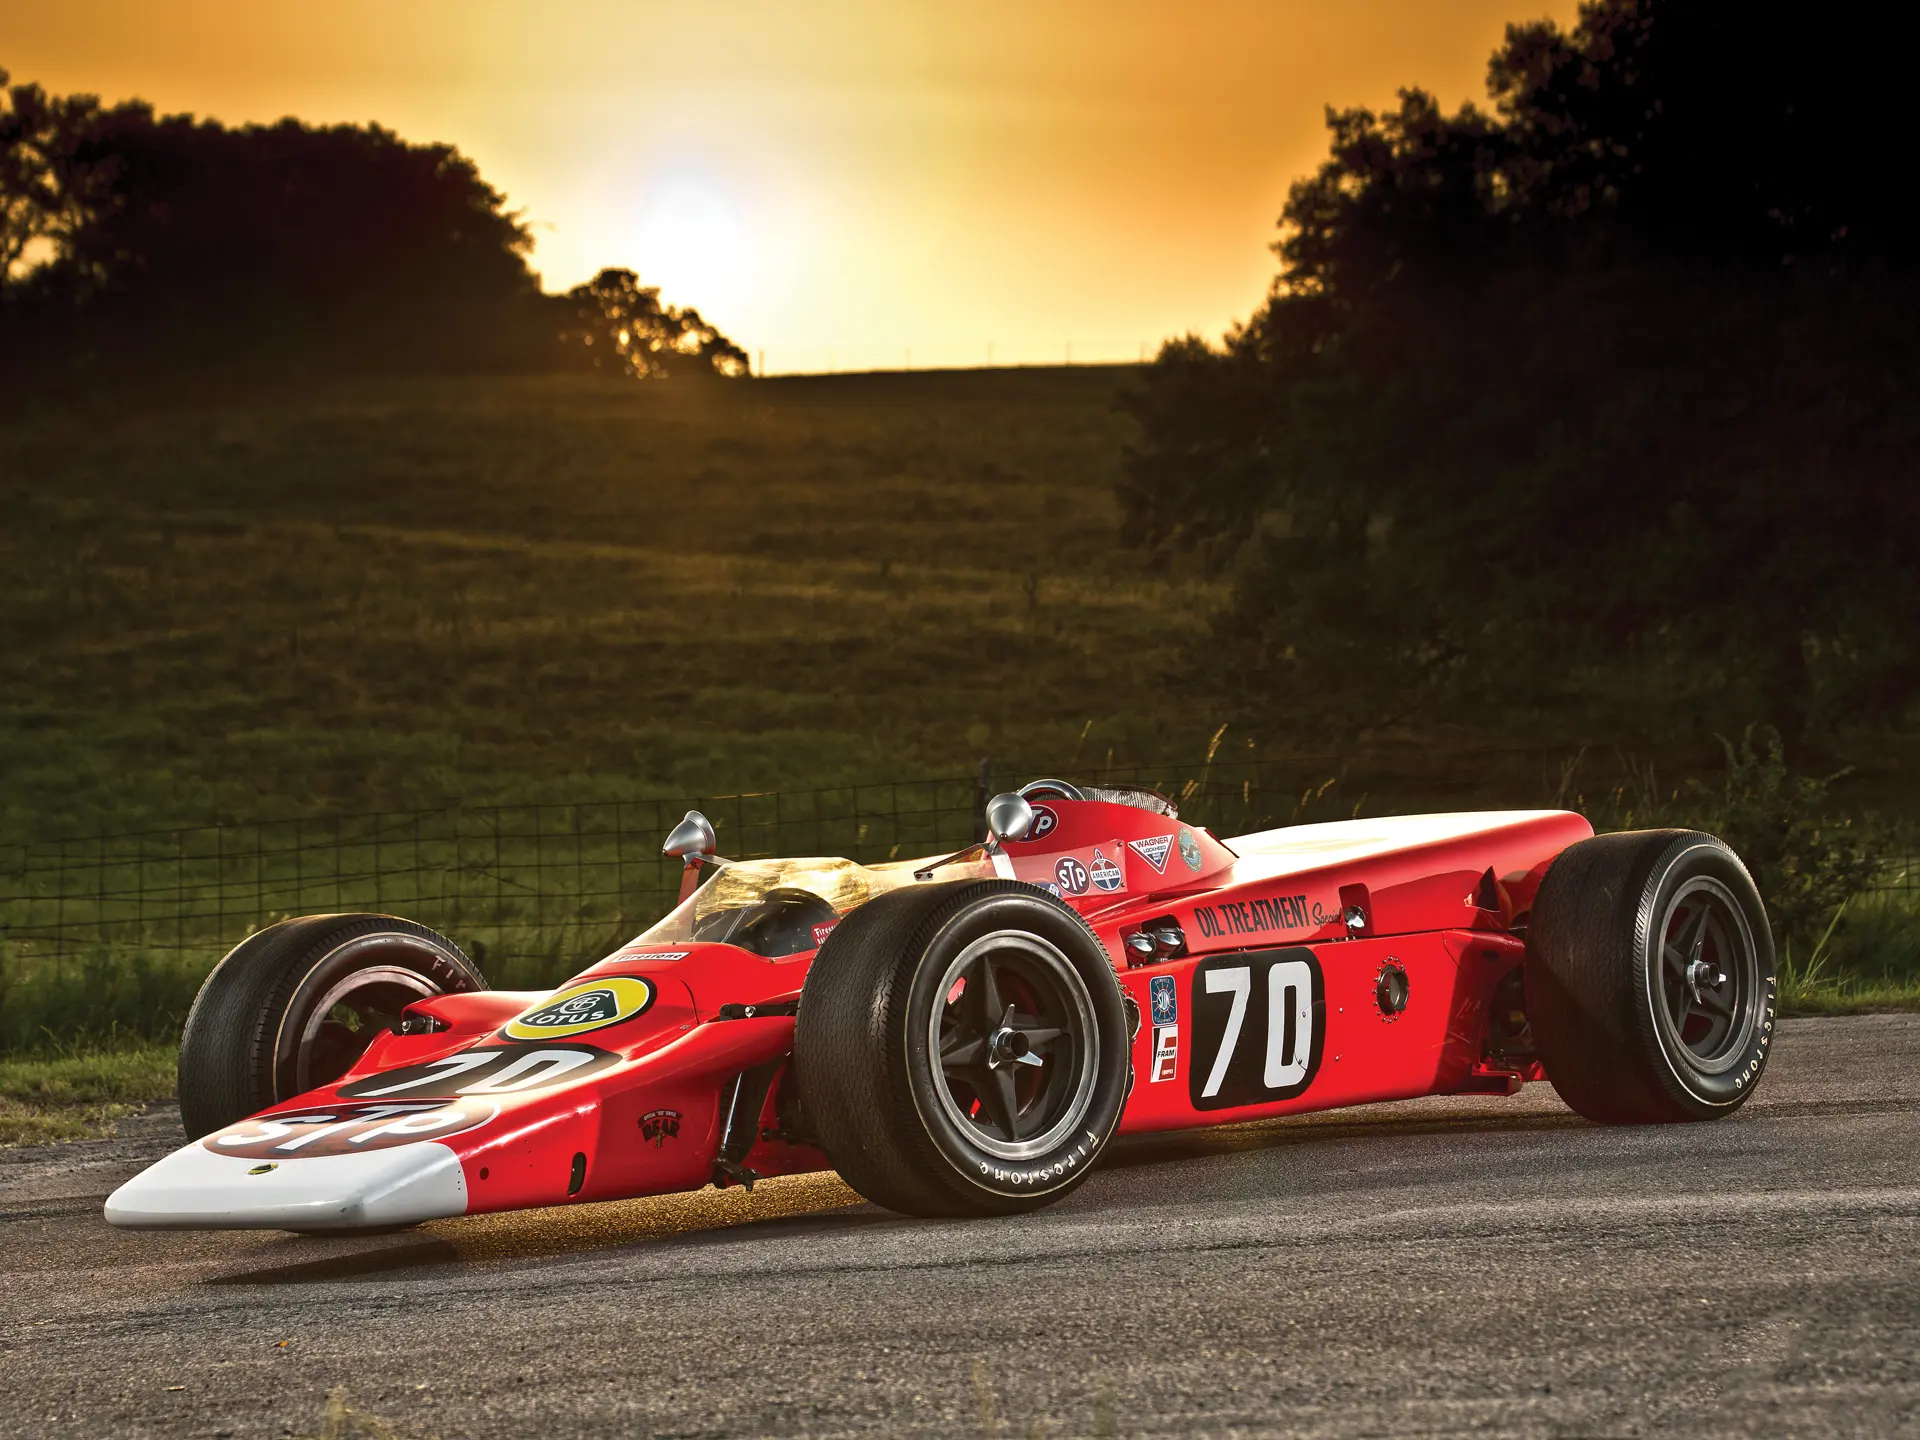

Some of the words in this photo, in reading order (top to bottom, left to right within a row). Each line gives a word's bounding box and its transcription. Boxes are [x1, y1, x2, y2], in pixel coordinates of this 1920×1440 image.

[1136, 837, 1169, 848] WAGNER
[1143, 845, 1167, 853] LOCKHEED
[1058, 861, 1087, 891] STP
[1092, 869, 1120, 879] AMERICAN
[1194, 907, 1226, 938] OIL
[1218, 895, 1310, 935] TREATMENT
[1312, 902, 1344, 928] Special
[526, 1010, 604, 1025] LOTUS
[1201, 961, 1312, 1098] 70
[1734, 976, 1777, 1089] Firestone
[1157, 1049, 1175, 1058] FRAM
[352, 1050, 595, 1097] 70
[216, 1102, 466, 1151] STP
[979, 1130, 1100, 1185] Firestone
